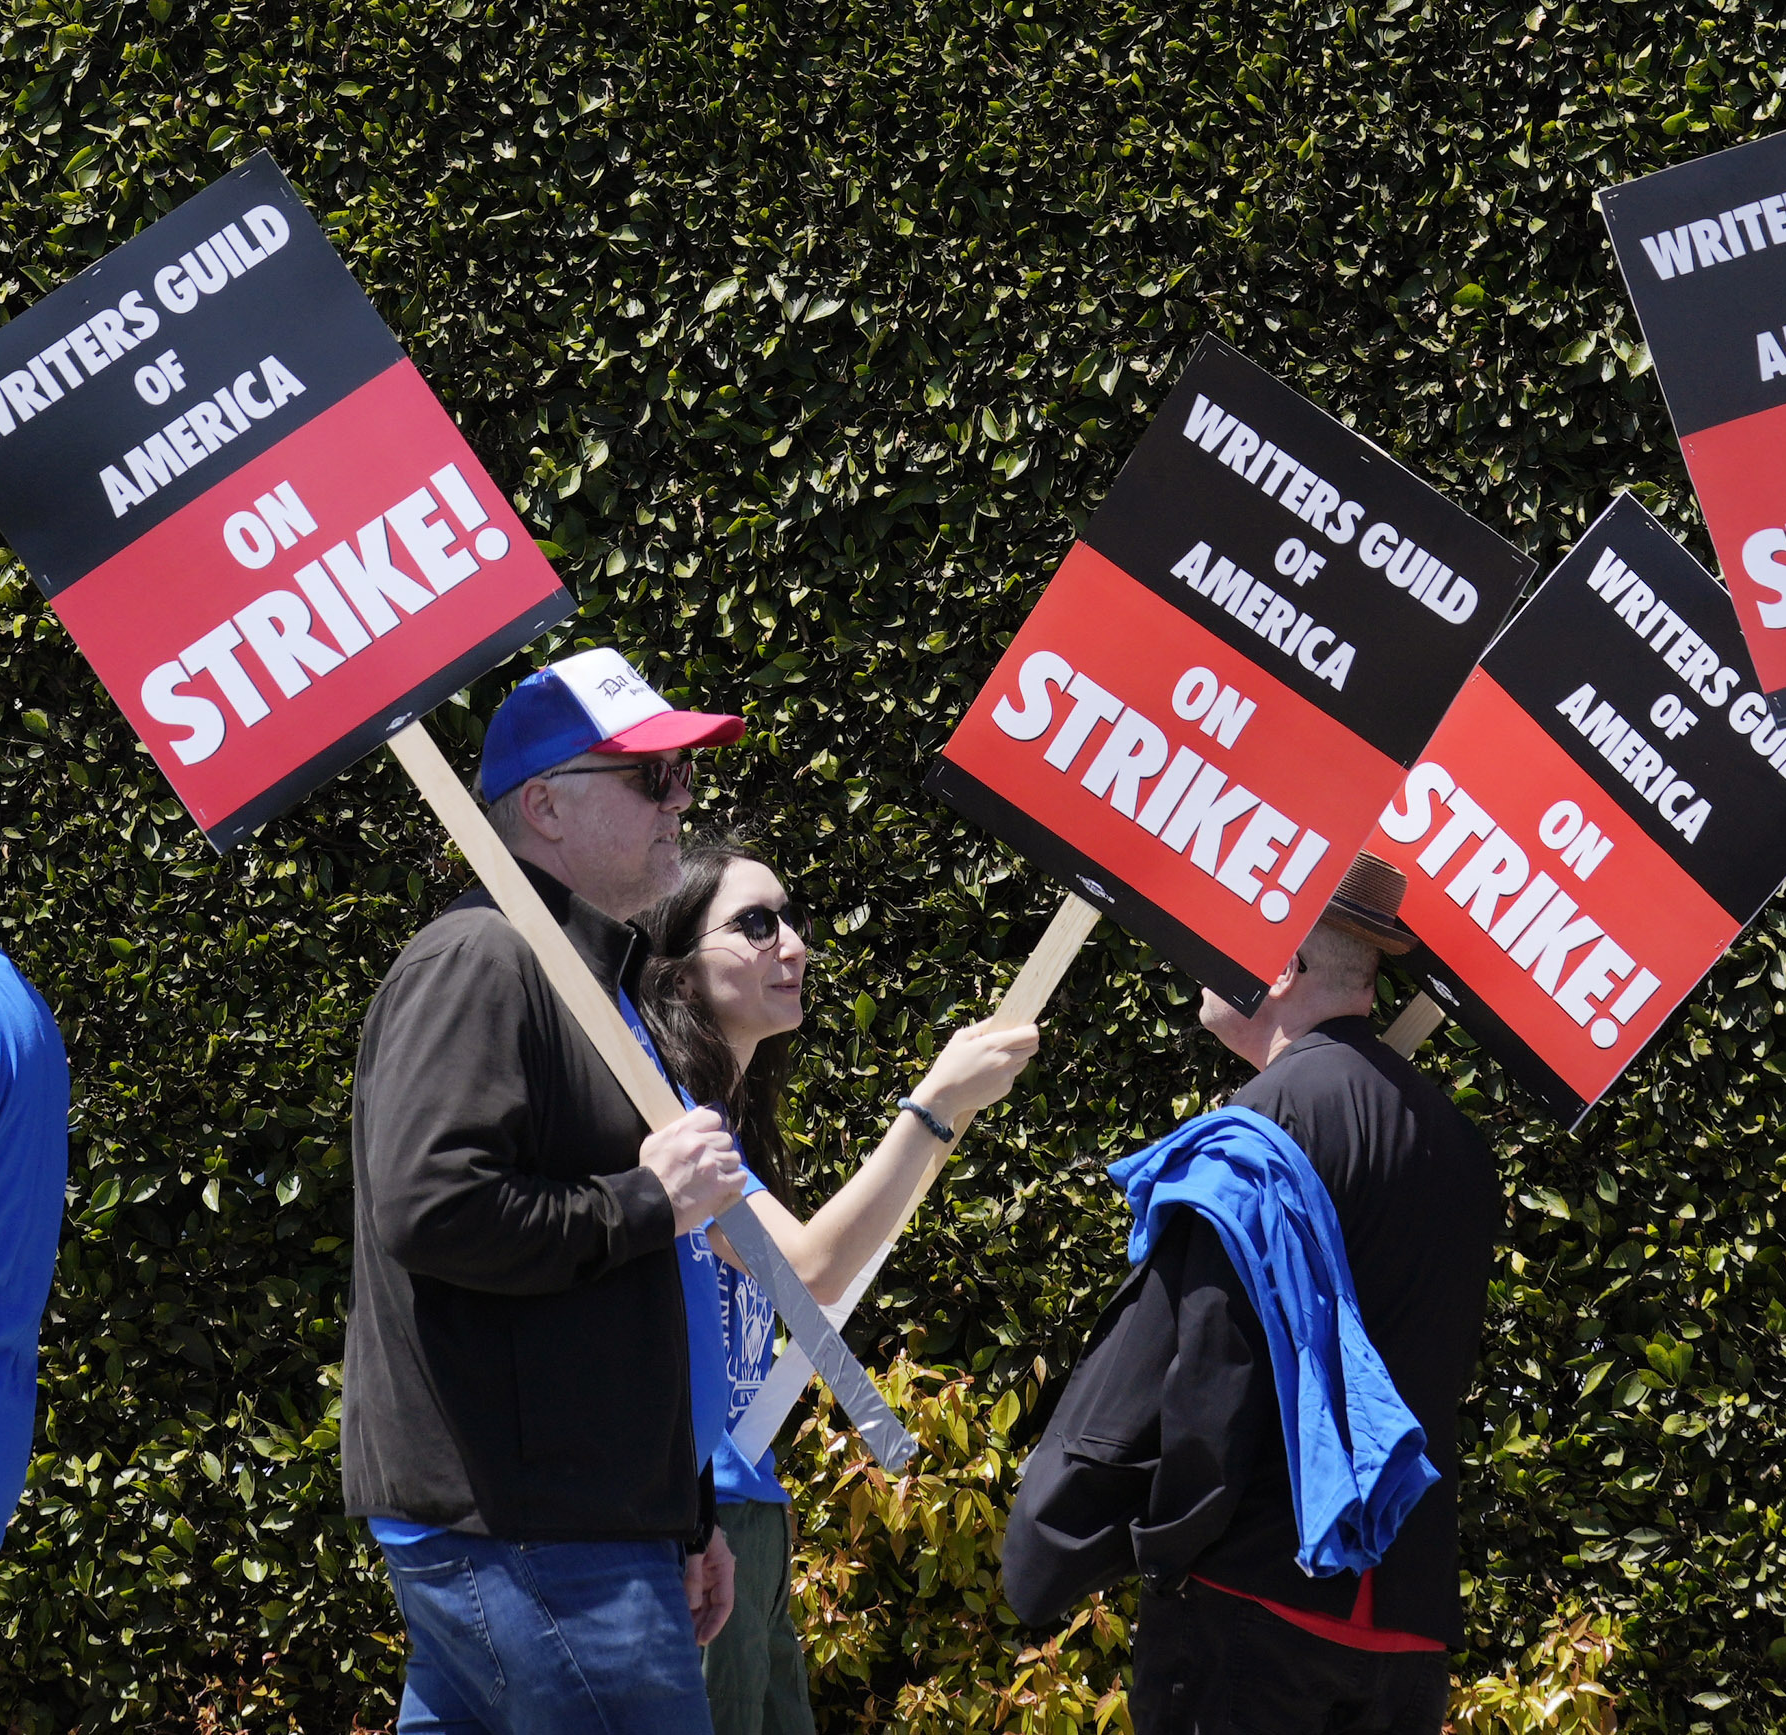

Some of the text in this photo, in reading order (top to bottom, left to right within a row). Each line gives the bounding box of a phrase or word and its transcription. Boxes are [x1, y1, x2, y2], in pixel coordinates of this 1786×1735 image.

[154, 205, 289, 313] GUILD
[100, 356, 306, 518] AMERICA
[135, 349, 186, 405] OF
[223, 480, 318, 569] ON
[1183, 394, 1477, 624] WRITERS GUILD
[1275, 538, 1326, 586] OF
[141, 463, 508, 765] STRIKE!
[1170, 541, 1355, 691] AMERICA
[1587, 547, 1740, 706] WRITERS
[1172, 667, 1257, 749] ON
[1556, 683, 1711, 844] AMERICA
[1650, 694, 1698, 740] OF
[992, 651, 1329, 921] STRIKE!
[1539, 800, 1614, 881] ON
[1378, 762, 1661, 1047] STRIKE!
